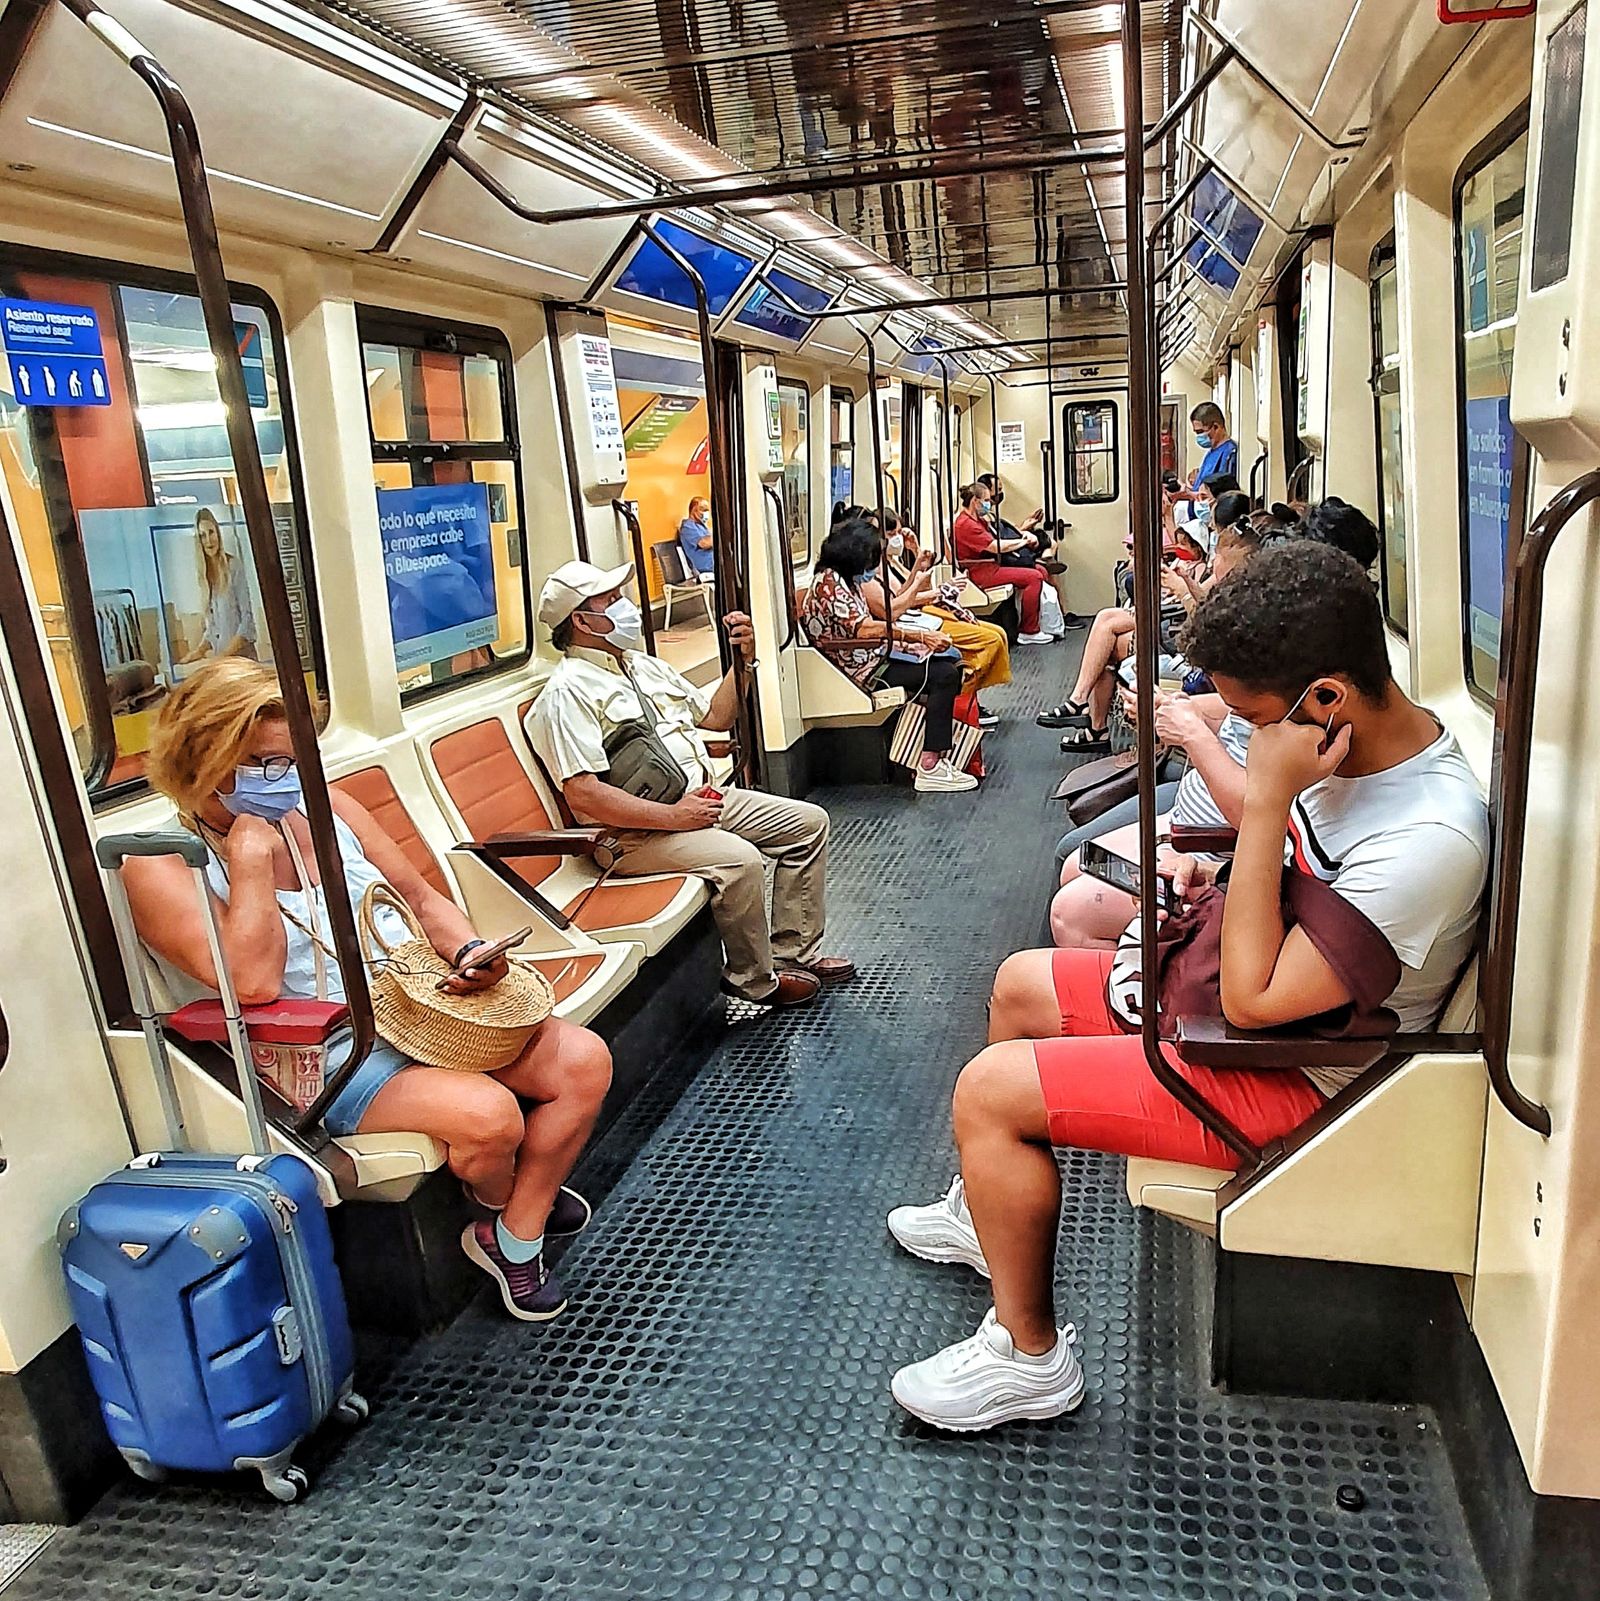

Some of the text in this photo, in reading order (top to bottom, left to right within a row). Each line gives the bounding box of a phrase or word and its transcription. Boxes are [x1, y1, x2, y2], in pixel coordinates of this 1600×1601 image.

[6, 307, 94, 327] Asiento reservado
[8, 320, 72, 337] Reserved seat
[402, 511, 414, 528] lo
[415, 511, 436, 530] que
[437, 503, 477, 523] necesita
[390, 533, 438, 553] empresa
[439, 526, 464, 544] cabe
